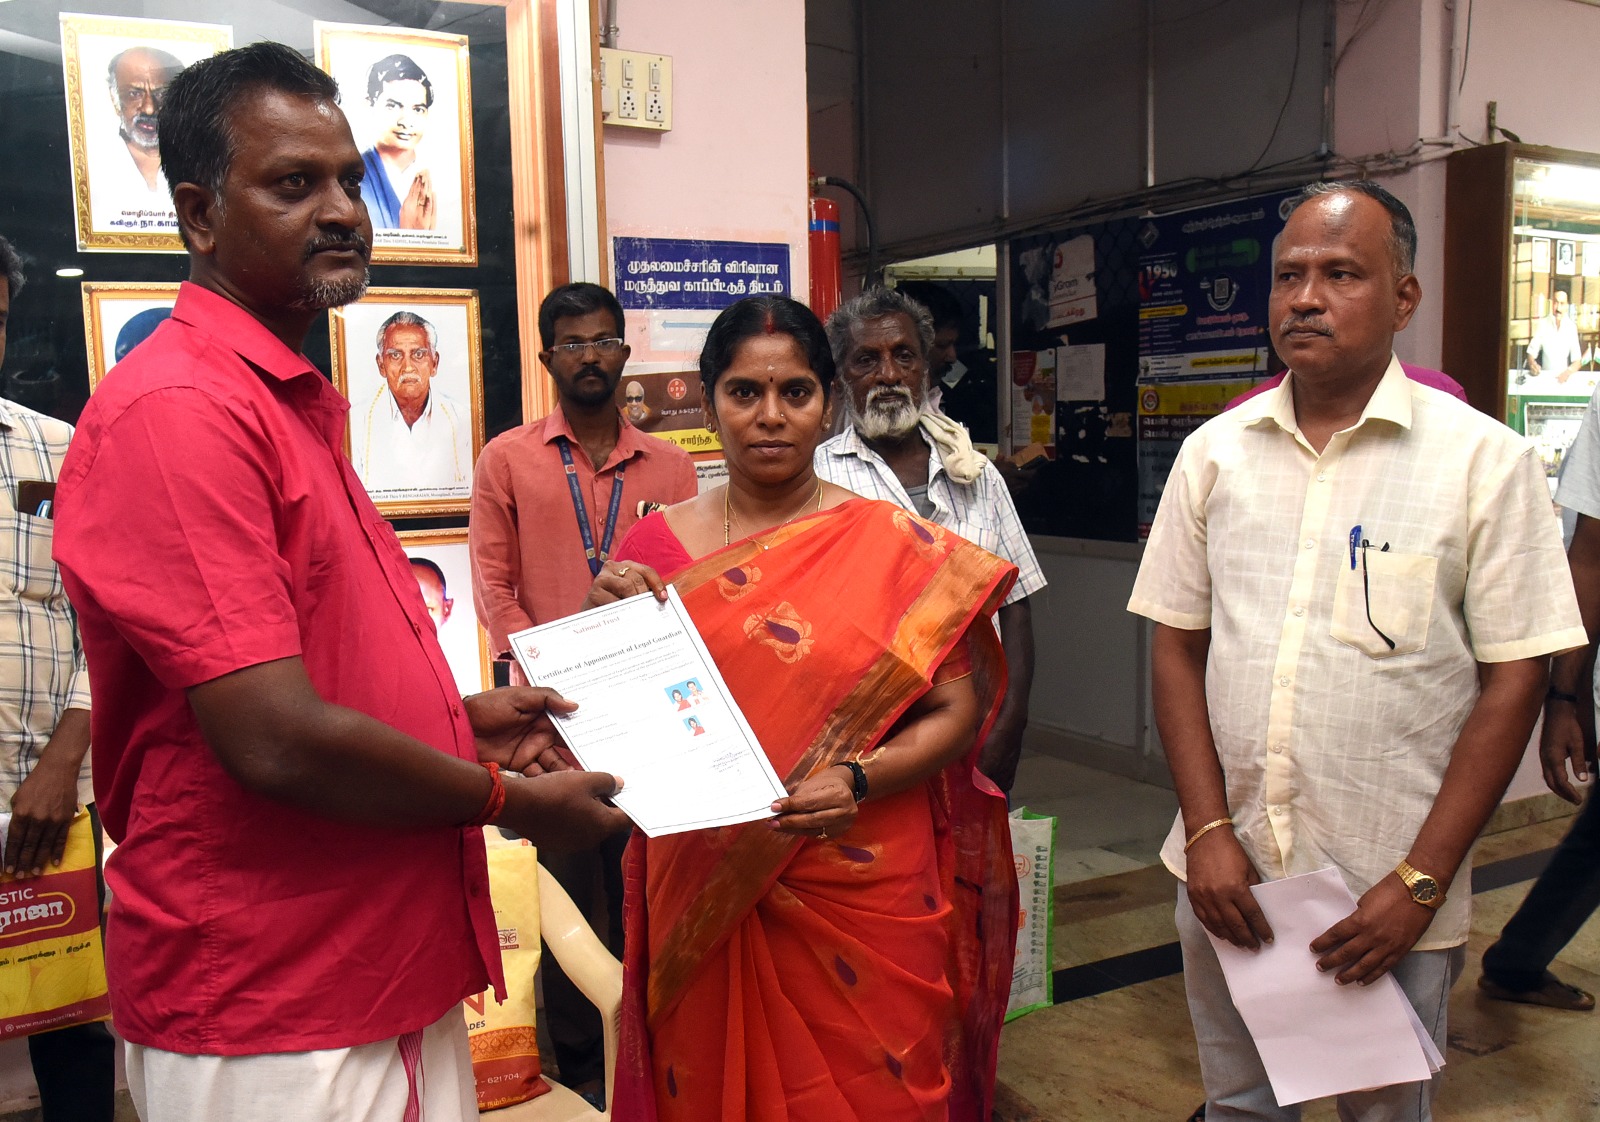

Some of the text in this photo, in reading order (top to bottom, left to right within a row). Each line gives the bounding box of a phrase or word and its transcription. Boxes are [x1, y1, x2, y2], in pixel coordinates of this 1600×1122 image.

[627, 258, 779, 275] முதலமைச்சரின் விரிவான
[624, 278, 784, 295] மருத்துவ காப்பீட்டுத் திட்டம்
[680, 434, 712, 446] சார்ந்த
[572, 621, 602, 635] National
[602, 616, 621, 627] Trust
[537, 665, 574, 682] Certificate
[576, 662, 583, 670] of
[583, 649, 626, 667] Appointment
[634, 639, 653, 652] Legal
[653, 629, 683, 643] Guardian
[66, 941, 91, 954] திருச்சி
[468, 1020, 486, 1031] DES
